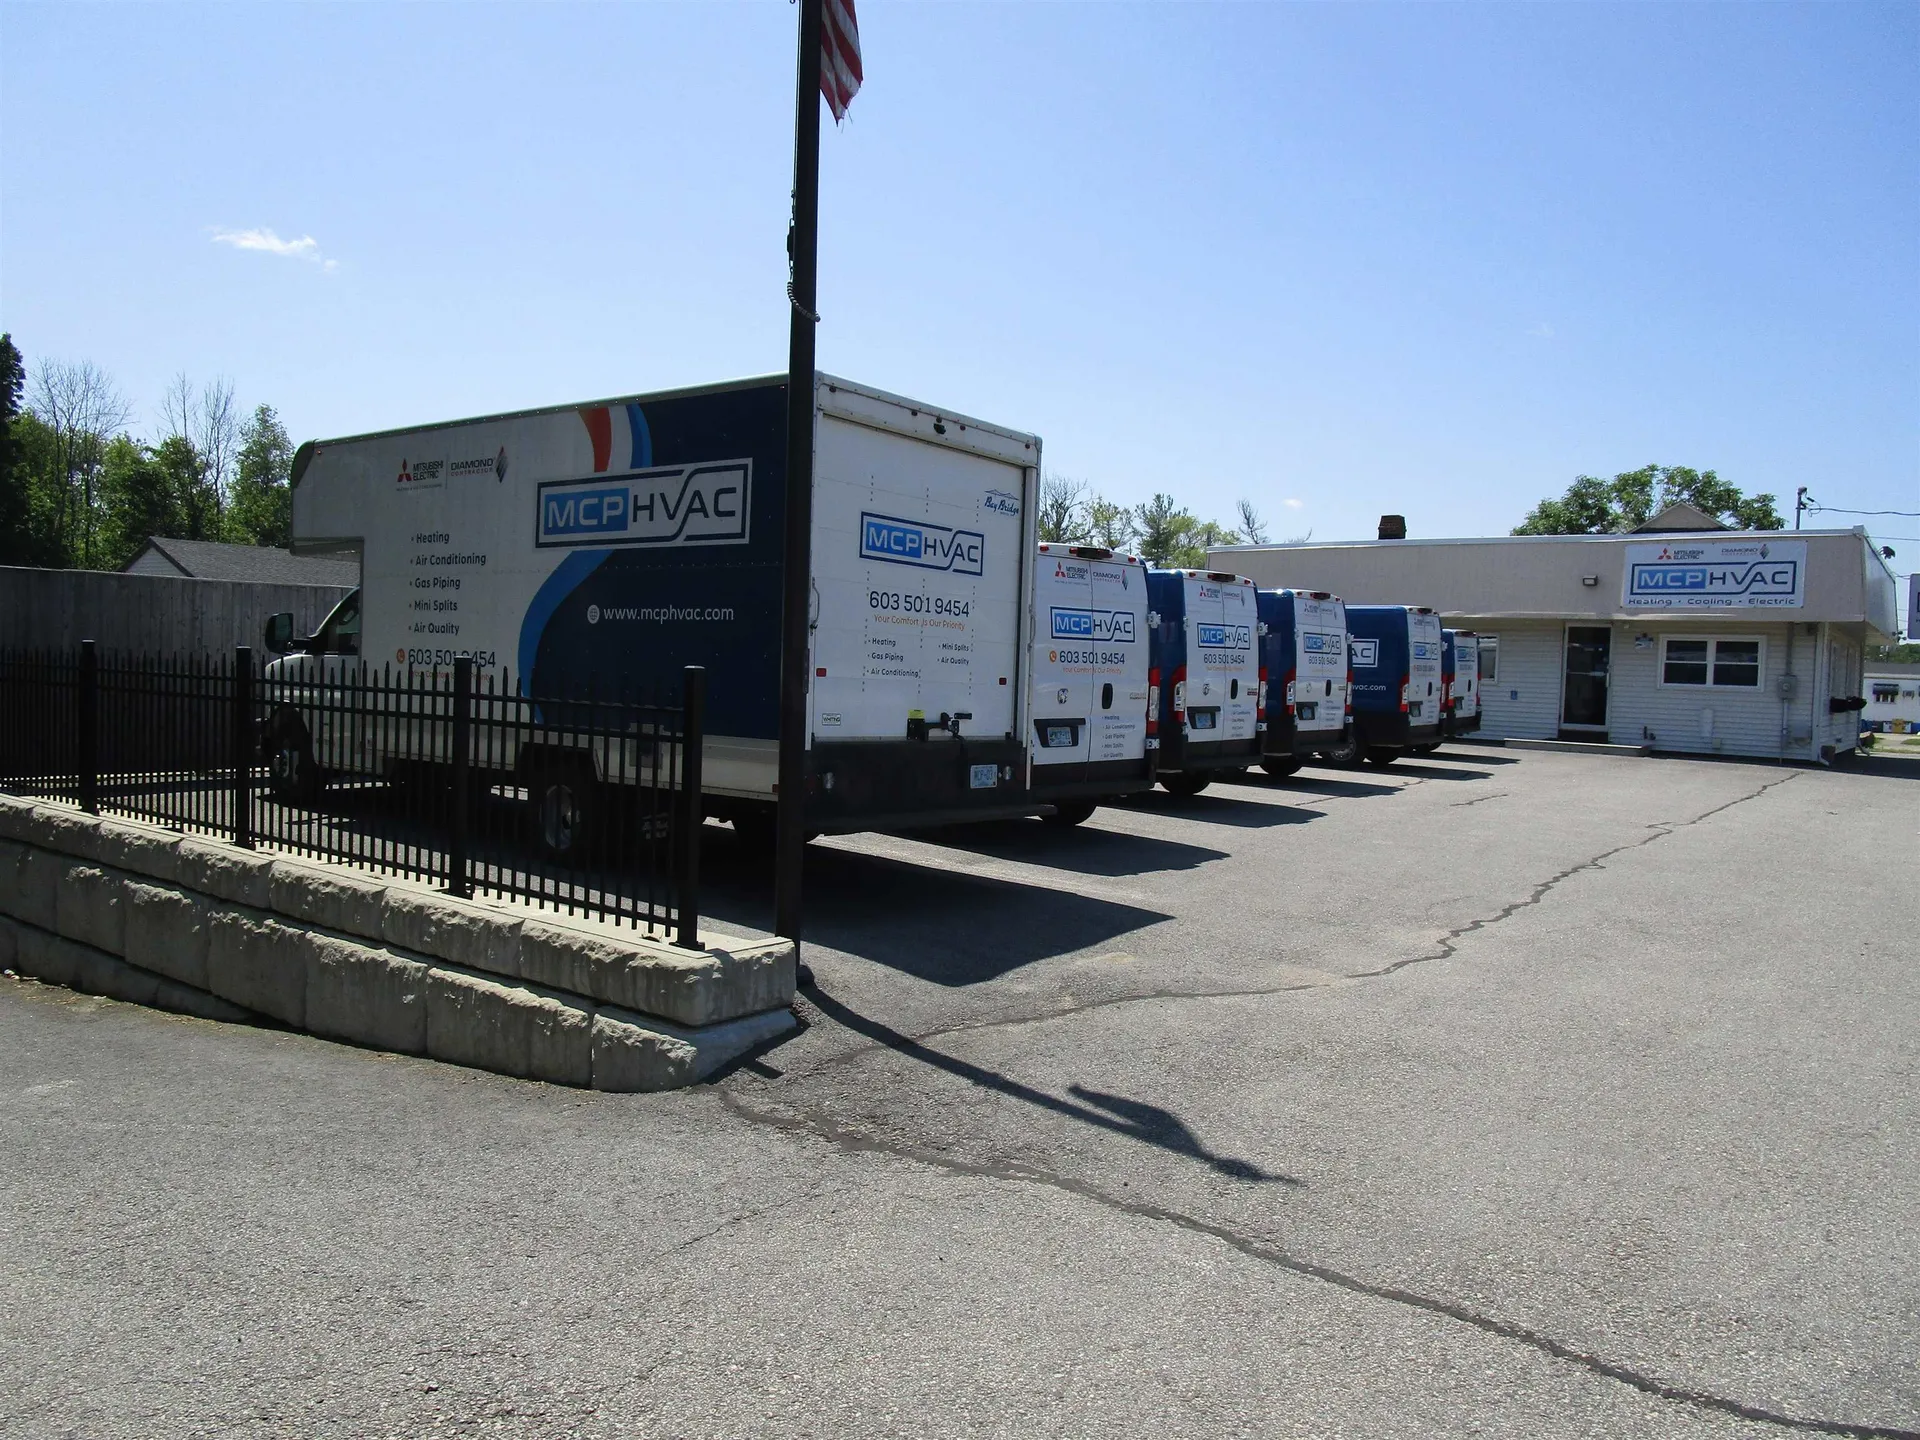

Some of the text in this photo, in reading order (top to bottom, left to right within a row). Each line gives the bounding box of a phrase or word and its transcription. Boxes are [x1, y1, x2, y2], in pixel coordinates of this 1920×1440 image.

[451, 458, 494, 471] DIAMOND
[413, 470, 439, 481] ELECTRIC
[984, 496, 1019, 517] Bay Bridge
[416, 531, 450, 545] Heating
[415, 552, 487, 566] Air Conditioning
[1092, 571, 1121, 580] DIAMOND
[415, 576, 461, 590] Gas Piping
[414, 599, 458, 613] Mini Splits
[869, 590, 970, 618] 603 501 9454
[1628, 597, 1795, 606] Heating Cooling Electric
[603, 605, 735, 625] www.mcphvac.com
[414, 622, 460, 636] Air Quality
[874, 614, 890, 623] Your
[891, 615, 919, 626] Comfort
[929, 618, 942, 628] Our
[943, 620, 966, 631] Priority
[872, 637, 896, 648] Heating
[941, 643, 970, 652] Mini Splits
[408, 648, 432, 665] 603
[871, 652, 904, 663] Gas Piping
[950, 657, 970, 666] Quality
[1060, 650, 1126, 665] 603 501 9454
[871, 667, 919, 679] Air Conditioning
